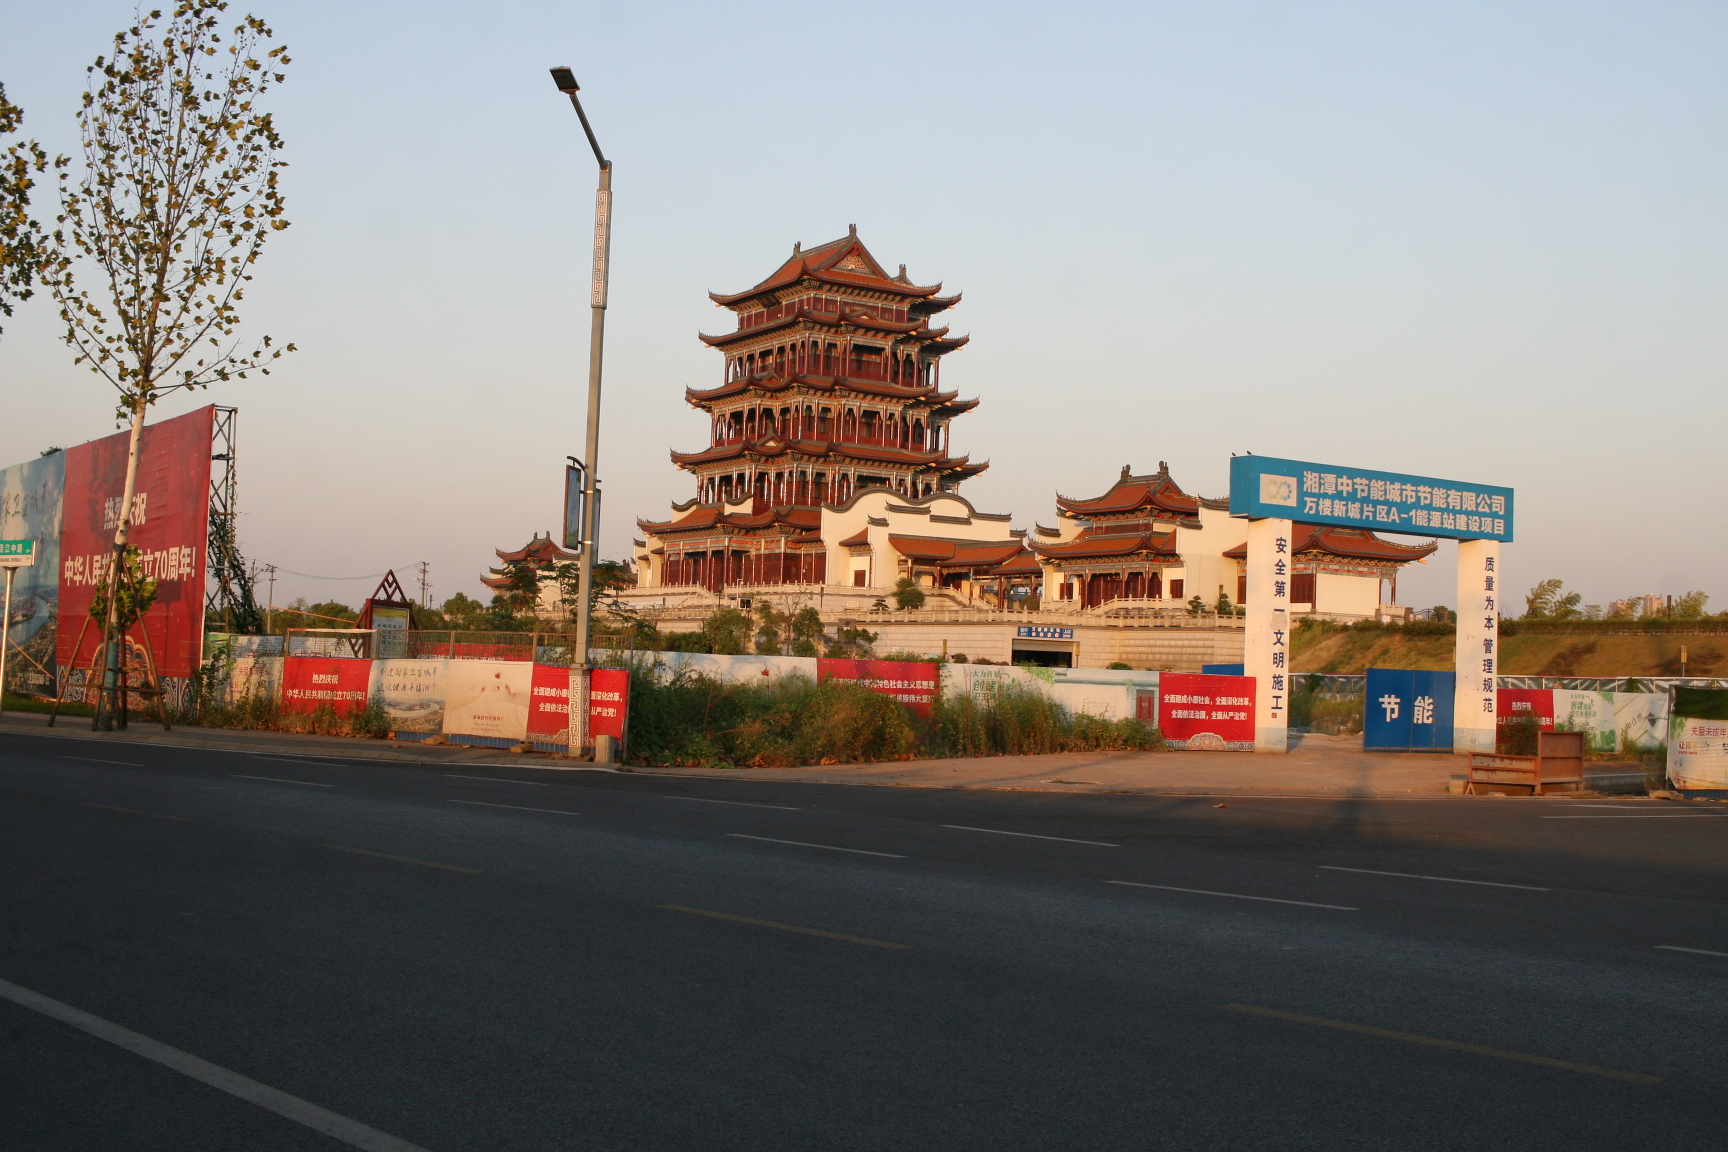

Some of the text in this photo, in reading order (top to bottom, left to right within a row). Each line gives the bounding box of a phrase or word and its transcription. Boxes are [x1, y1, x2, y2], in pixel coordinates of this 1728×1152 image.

[1303, 471, 1505, 515] 湘潭中节能城市节能有限公司
[1304, 497, 1505, 535] 万楼新城片区A-1能源站建设项目
[312, 673, 339, 684] 热烈庆祝
[1379, 694, 1435, 725] 节能
